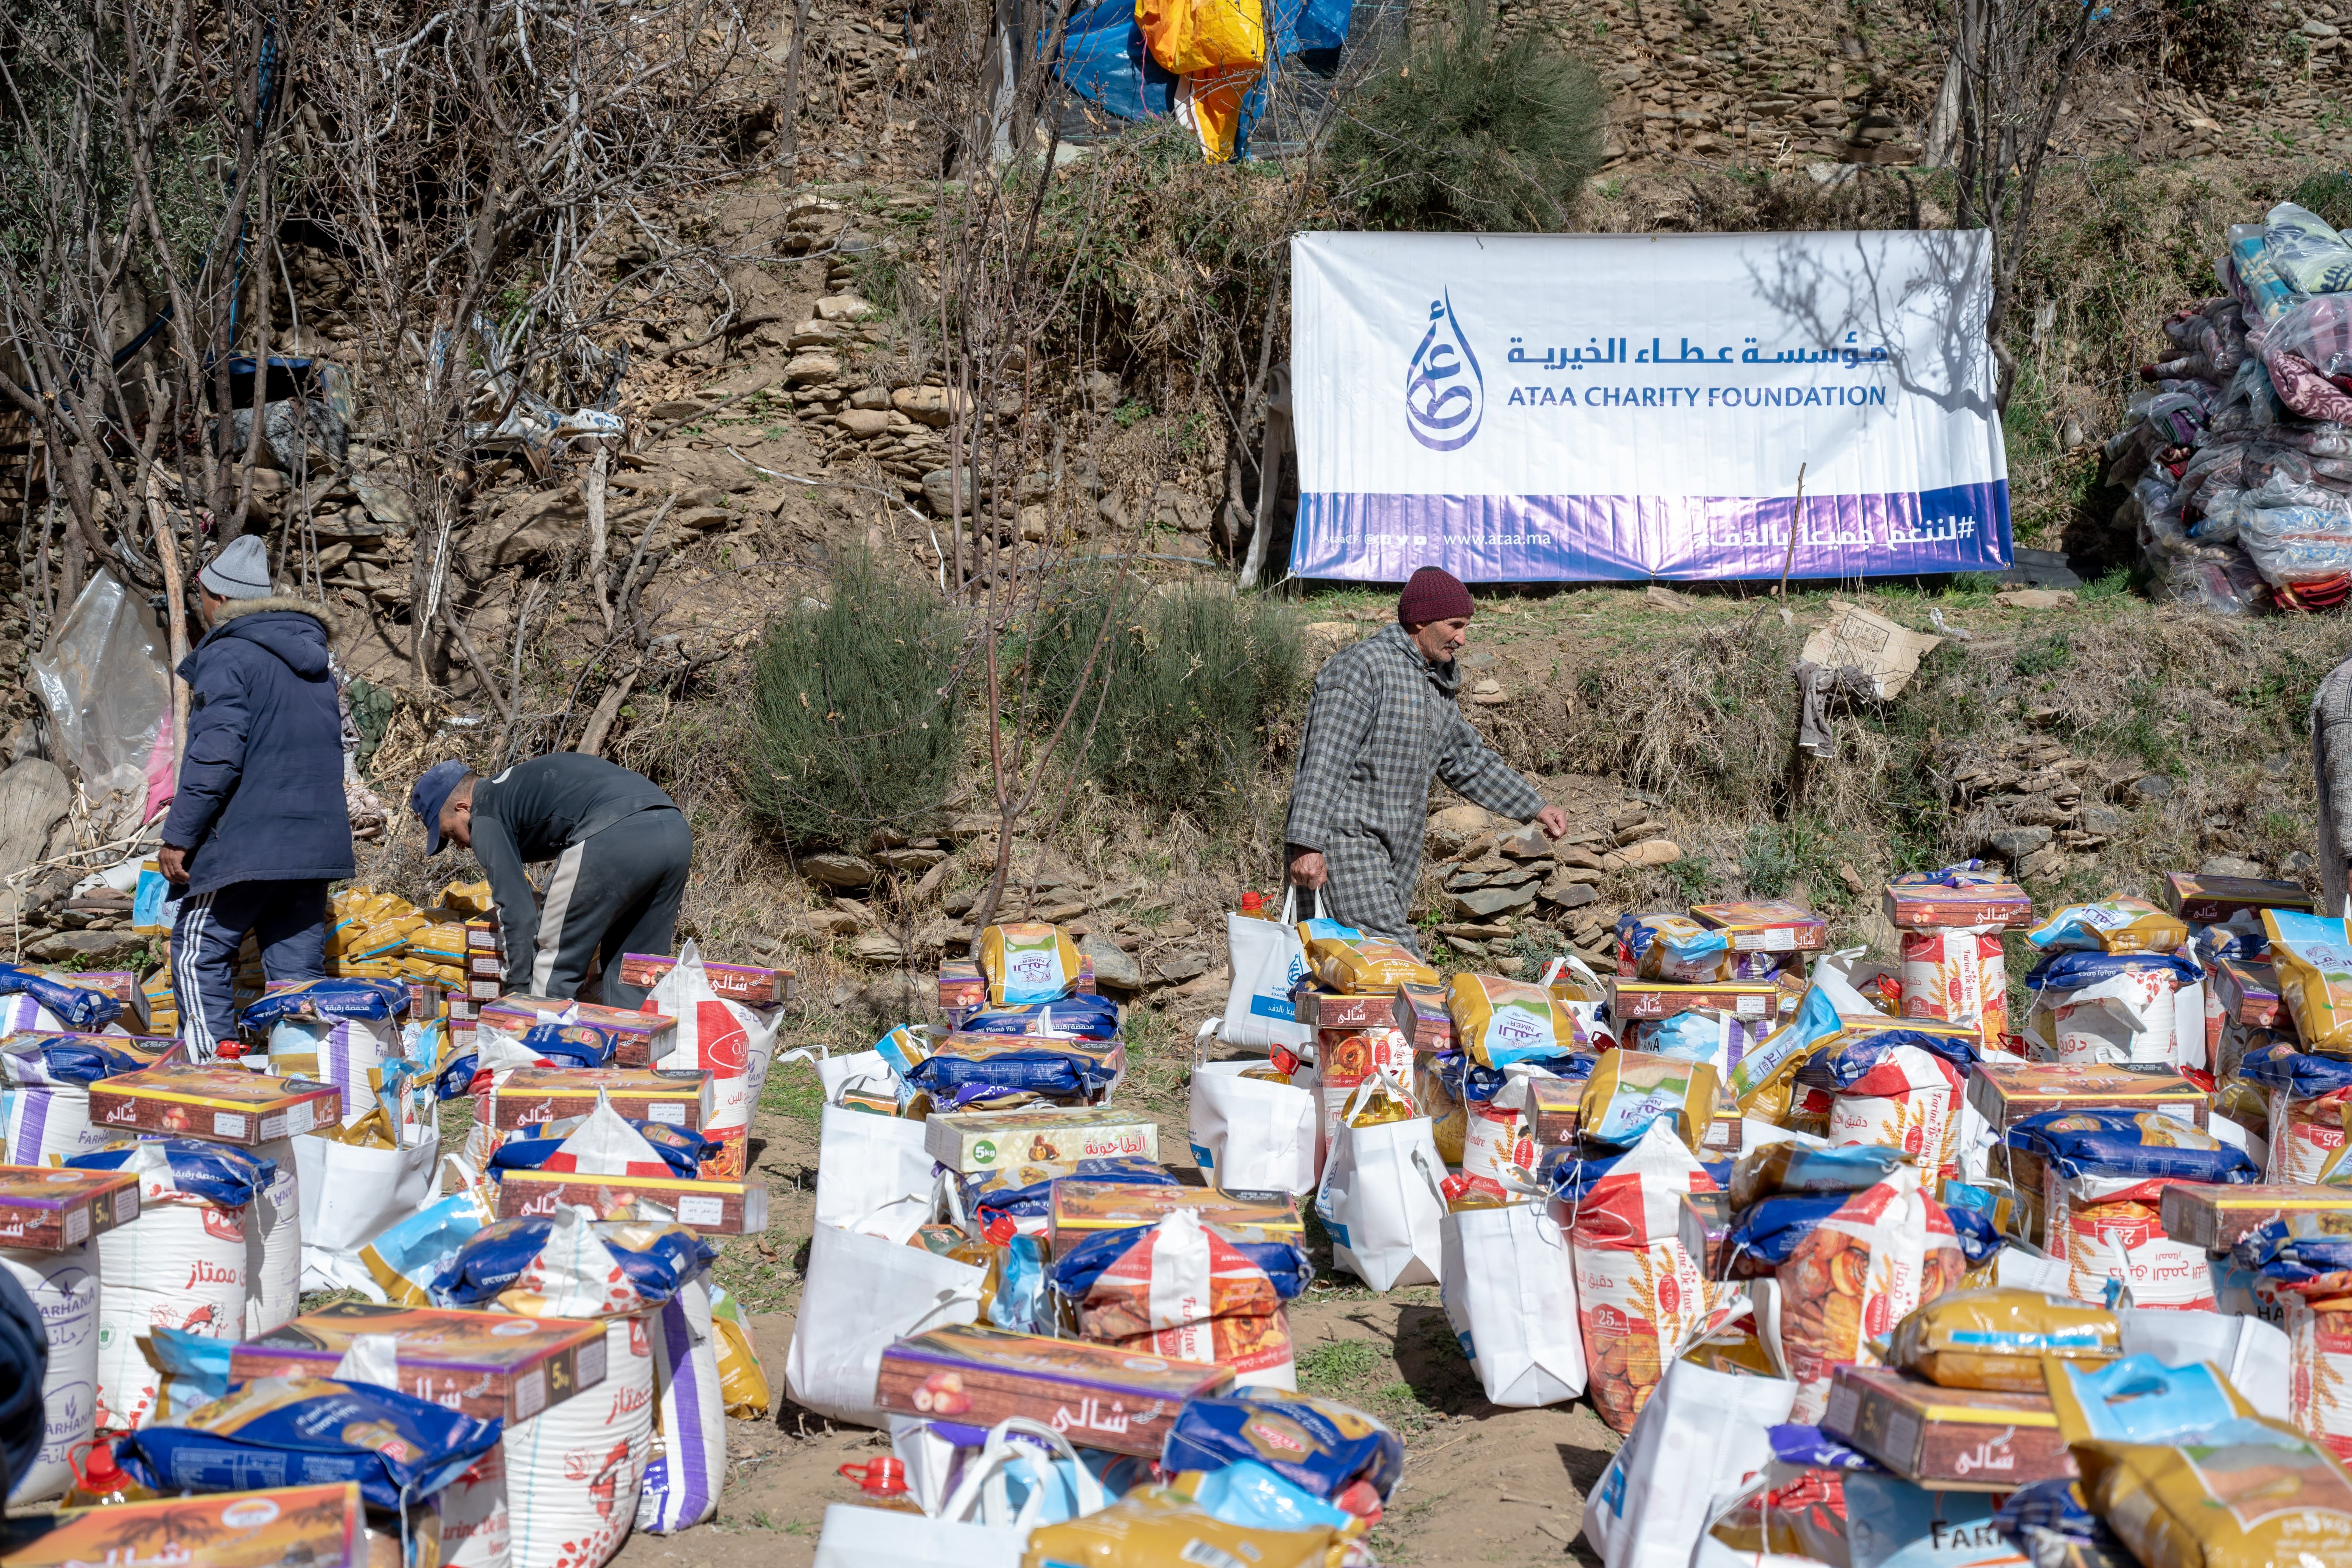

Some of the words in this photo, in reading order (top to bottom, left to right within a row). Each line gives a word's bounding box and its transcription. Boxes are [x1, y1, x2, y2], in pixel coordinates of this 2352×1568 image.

[1507, 337, 1627, 370] الخيرية
[1634, 337, 1734, 363] عطاء
[1741, 331, 1888, 369] مؤسسة
[1507, 386, 1577, 406] ATAA
[1585, 387, 1701, 407] CHARITY
[1709, 385, 1886, 407] FOUNDATION
[1322, 534, 1359, 544] AtaaCF
[1443, 534, 1551, 545] www.ataa.ma
[1963, 949, 1971, 973] Farine
[1967, 974, 1974, 984] De
[1912, 1001, 1922, 1011] 25
[1636, 1038, 1660, 1052] RHANA
[1929, 1093, 1942, 1125] Farine
[1085, 1135, 1149, 1157] الطاحونة
[2322, 1133, 2343, 1147] 25
[975, 1146, 996, 1158] 5kg
[185, 1258, 236, 1290] ممتاز
[1588, 1272, 1614, 1290] دقيق
[2153, 1260, 2189, 1281] القمح
[1598, 1309, 1615, 1326] 25
[44, 1405, 94, 1436] ARHANA
[1052, 1396, 1129, 1434] شالى
